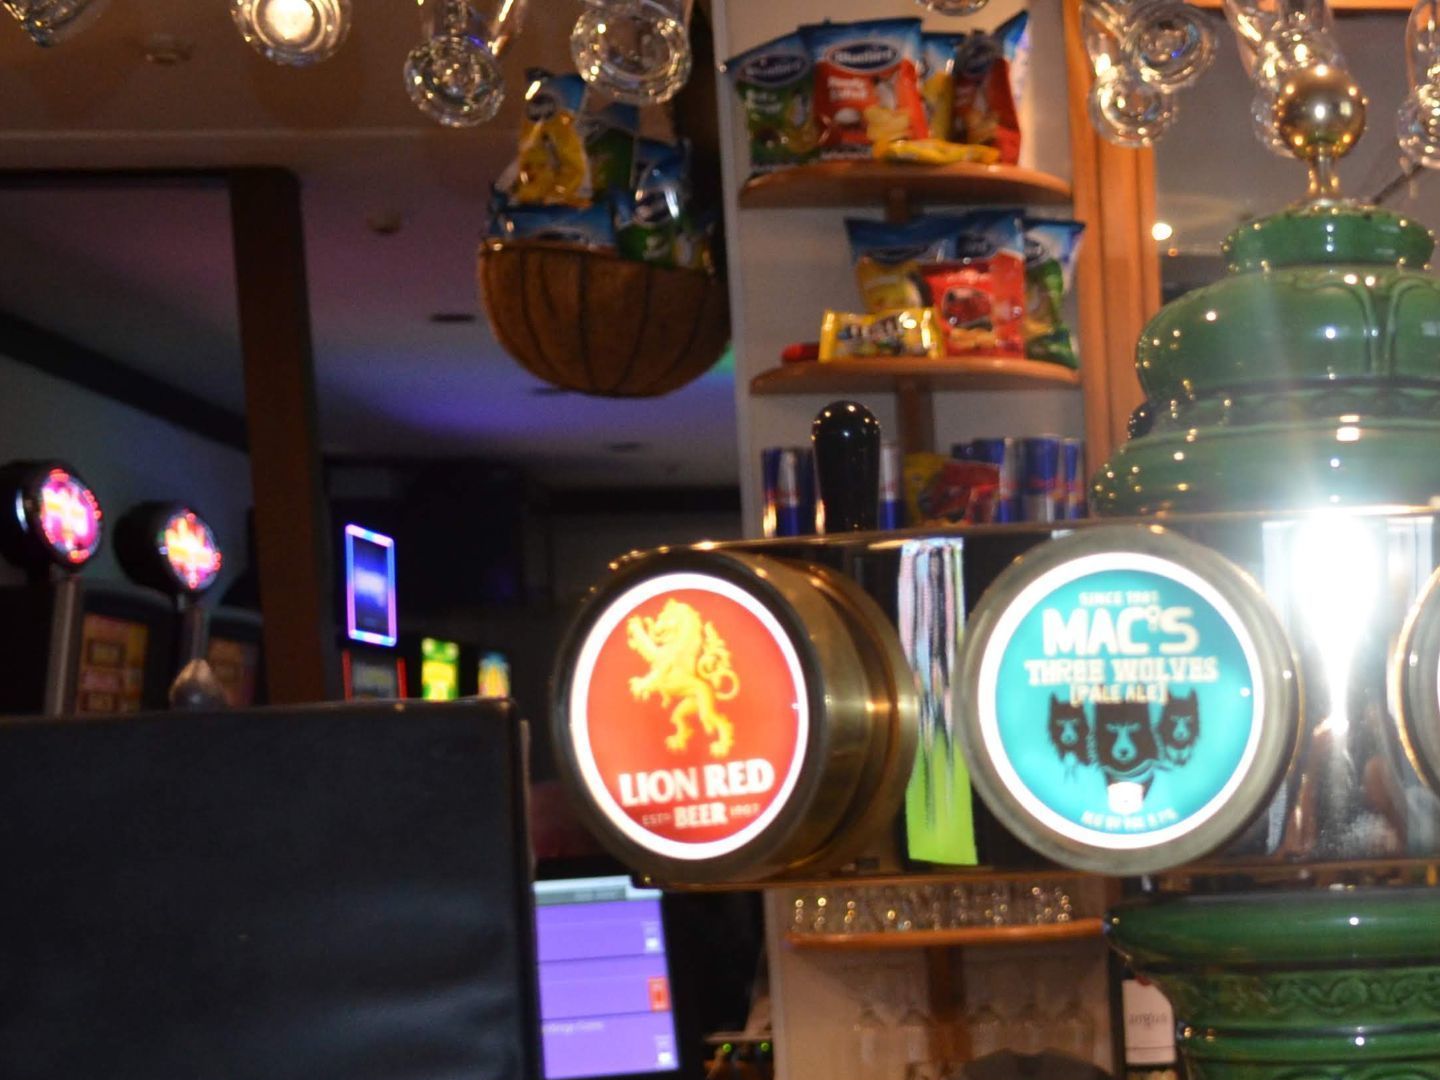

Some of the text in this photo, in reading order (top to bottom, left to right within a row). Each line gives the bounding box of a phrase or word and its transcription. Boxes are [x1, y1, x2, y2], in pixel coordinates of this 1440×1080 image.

[1042, 605, 1201, 657] MAC'S
[1023, 655, 1220, 686] THREE WOLVES
[618, 757, 776, 807] LION RED
[673, 802, 728, 829] BEER
